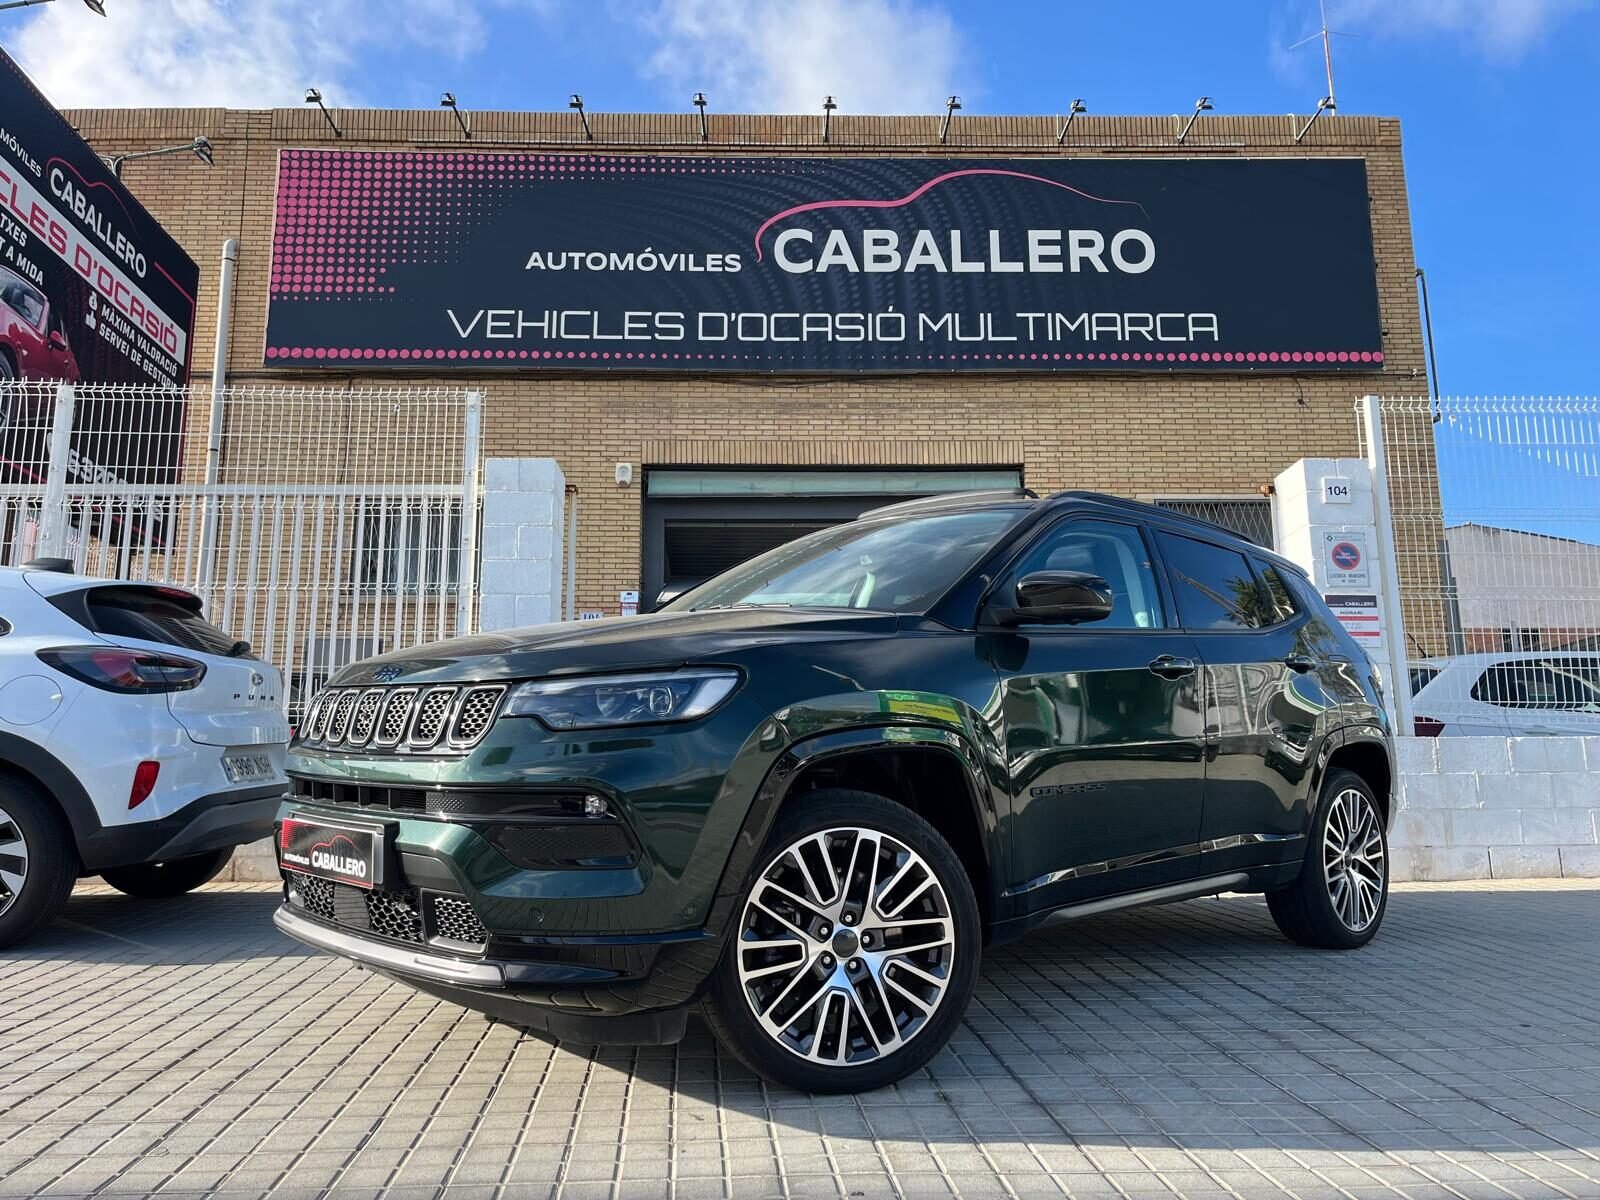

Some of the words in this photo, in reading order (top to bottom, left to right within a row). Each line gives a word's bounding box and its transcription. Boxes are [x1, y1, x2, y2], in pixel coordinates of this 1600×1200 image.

[50, 166, 147, 279] CABALLERO
[5, 246, 14, 262] A
[16, 252, 44, 287] MIDA
[525, 246, 742, 274] AUTOMÓVILES
[774, 228, 1156, 275] CABALLERO
[74, 242, 177, 355] D'OCASIÓ
[99, 323, 131, 357] SERVEI
[130, 349, 141, 366] DE
[101, 303, 135, 342] MÀXIMA
[137, 334, 178, 378] VALORACIÓ
[447, 309, 686, 342] VEHICLES
[698, 305, 906, 343] D'OCASIÓ
[918, 312, 1220, 342] MULTIMARCA
[1327, 485, 1348, 496] 104
[311, 850, 367, 878] CABALLERO
